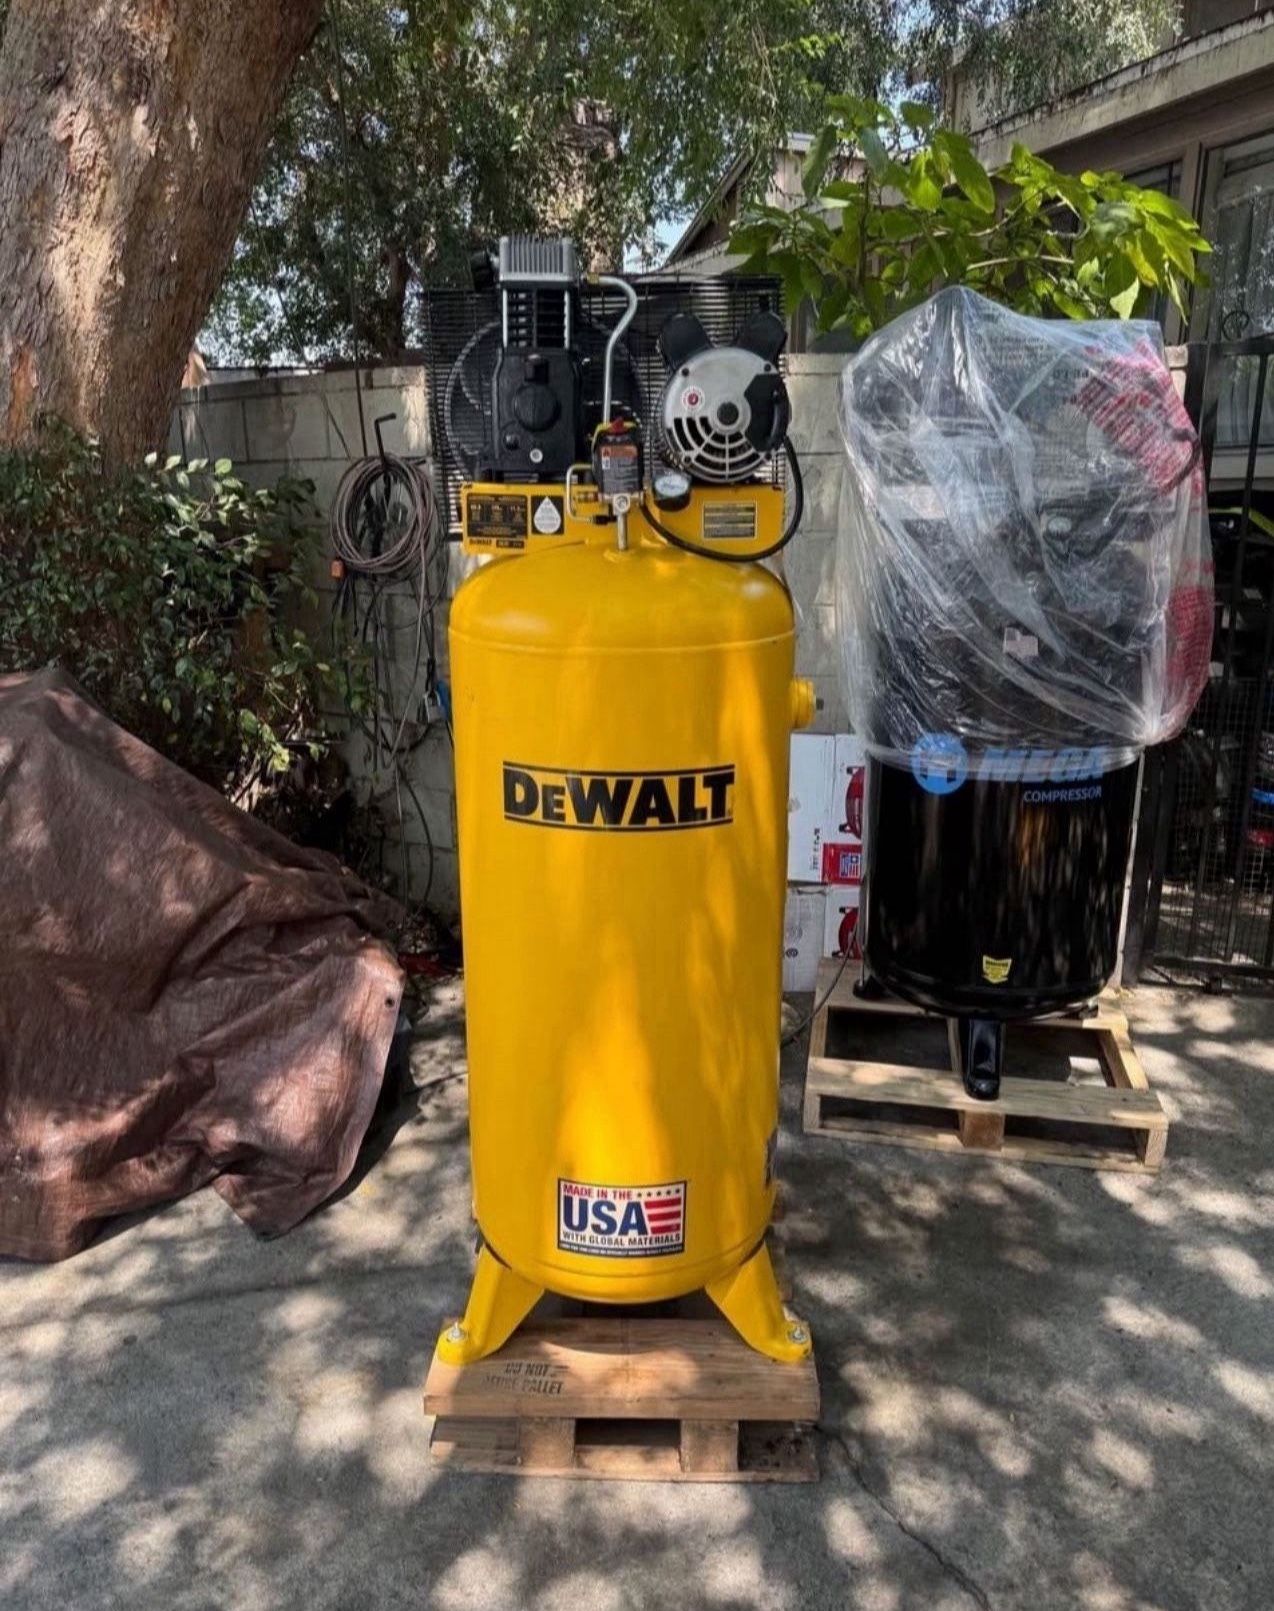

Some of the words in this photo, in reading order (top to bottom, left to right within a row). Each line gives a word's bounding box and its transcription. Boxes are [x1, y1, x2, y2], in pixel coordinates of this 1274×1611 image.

[1024, 786, 1102, 803] COMPRESSOR
[563, 1184, 593, 1198] MADE
[597, 1188, 608, 1199] IN
[613, 1190, 632, 1200] THE
[563, 1195, 648, 1236] USA
[563, 1231, 587, 1242] WITH
[589, 1235, 625, 1247] GLOBAL
[628, 1233, 681, 1246] MATERIALS
[525, 1363, 551, 1377] NOT
